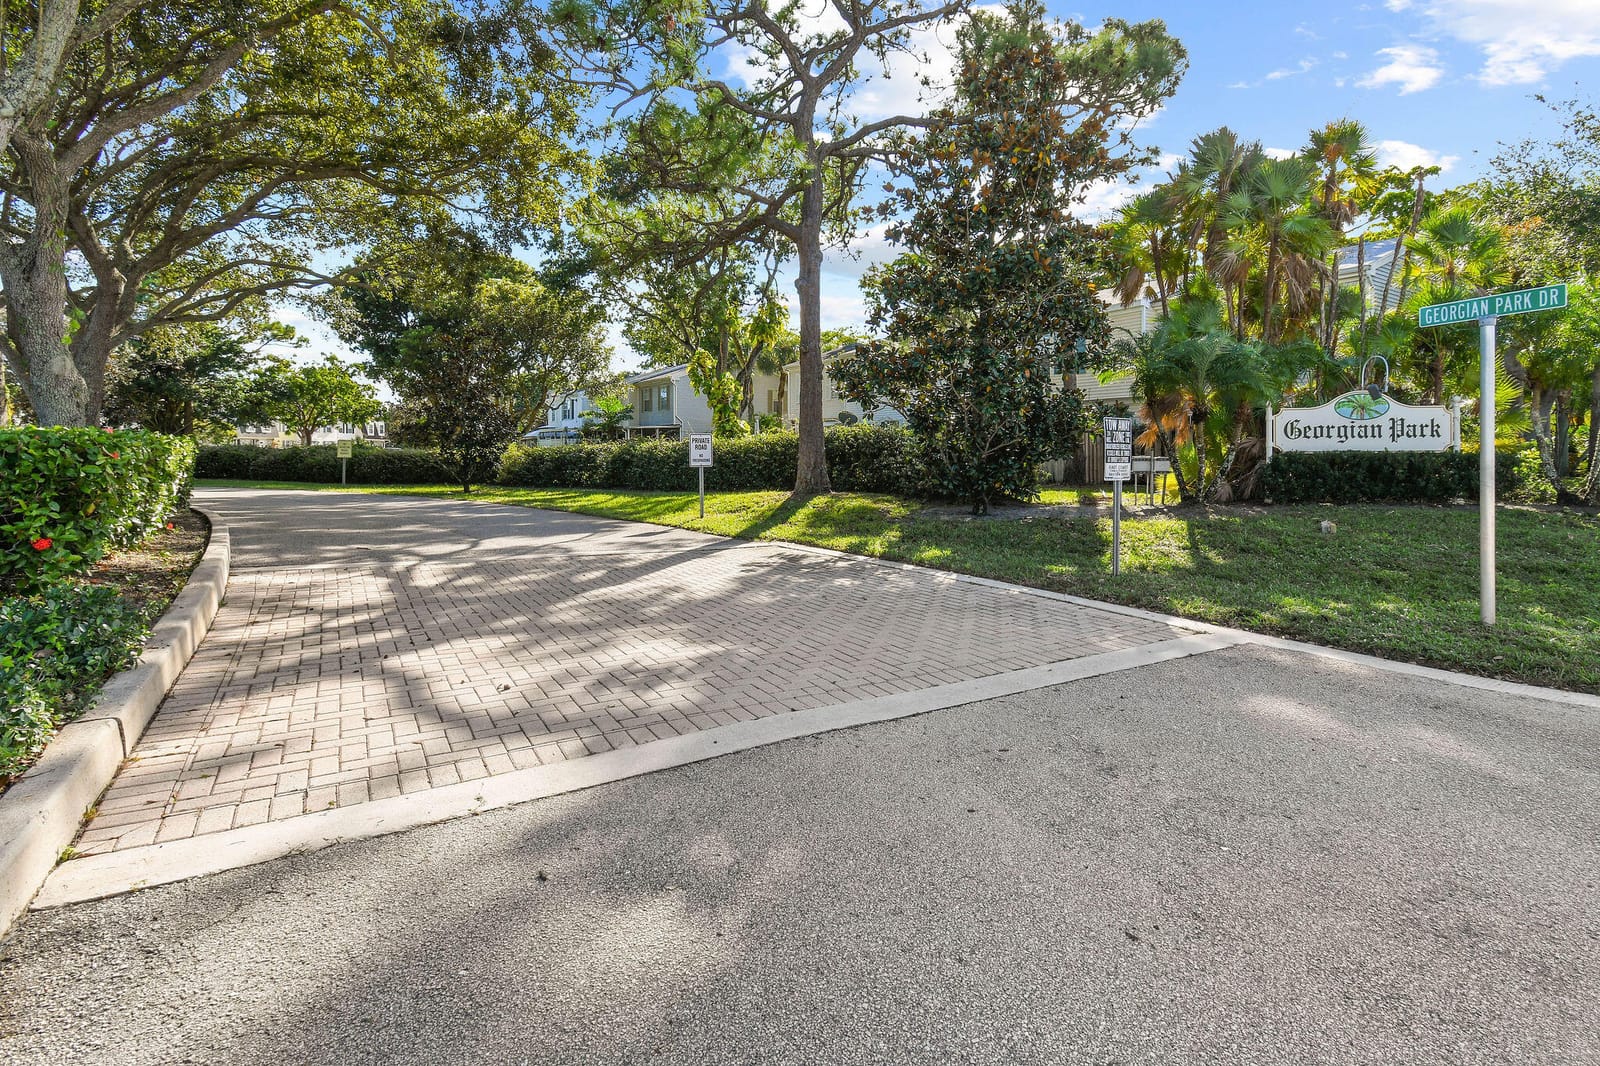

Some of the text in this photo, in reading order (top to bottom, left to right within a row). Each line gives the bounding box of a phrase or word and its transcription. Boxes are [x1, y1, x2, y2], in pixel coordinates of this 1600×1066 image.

[1425, 288, 1559, 324] GEORGIAN PARK DR
[1112, 431, 1125, 443] ZONE
[1283, 417, 1442, 444] Georgian Park
